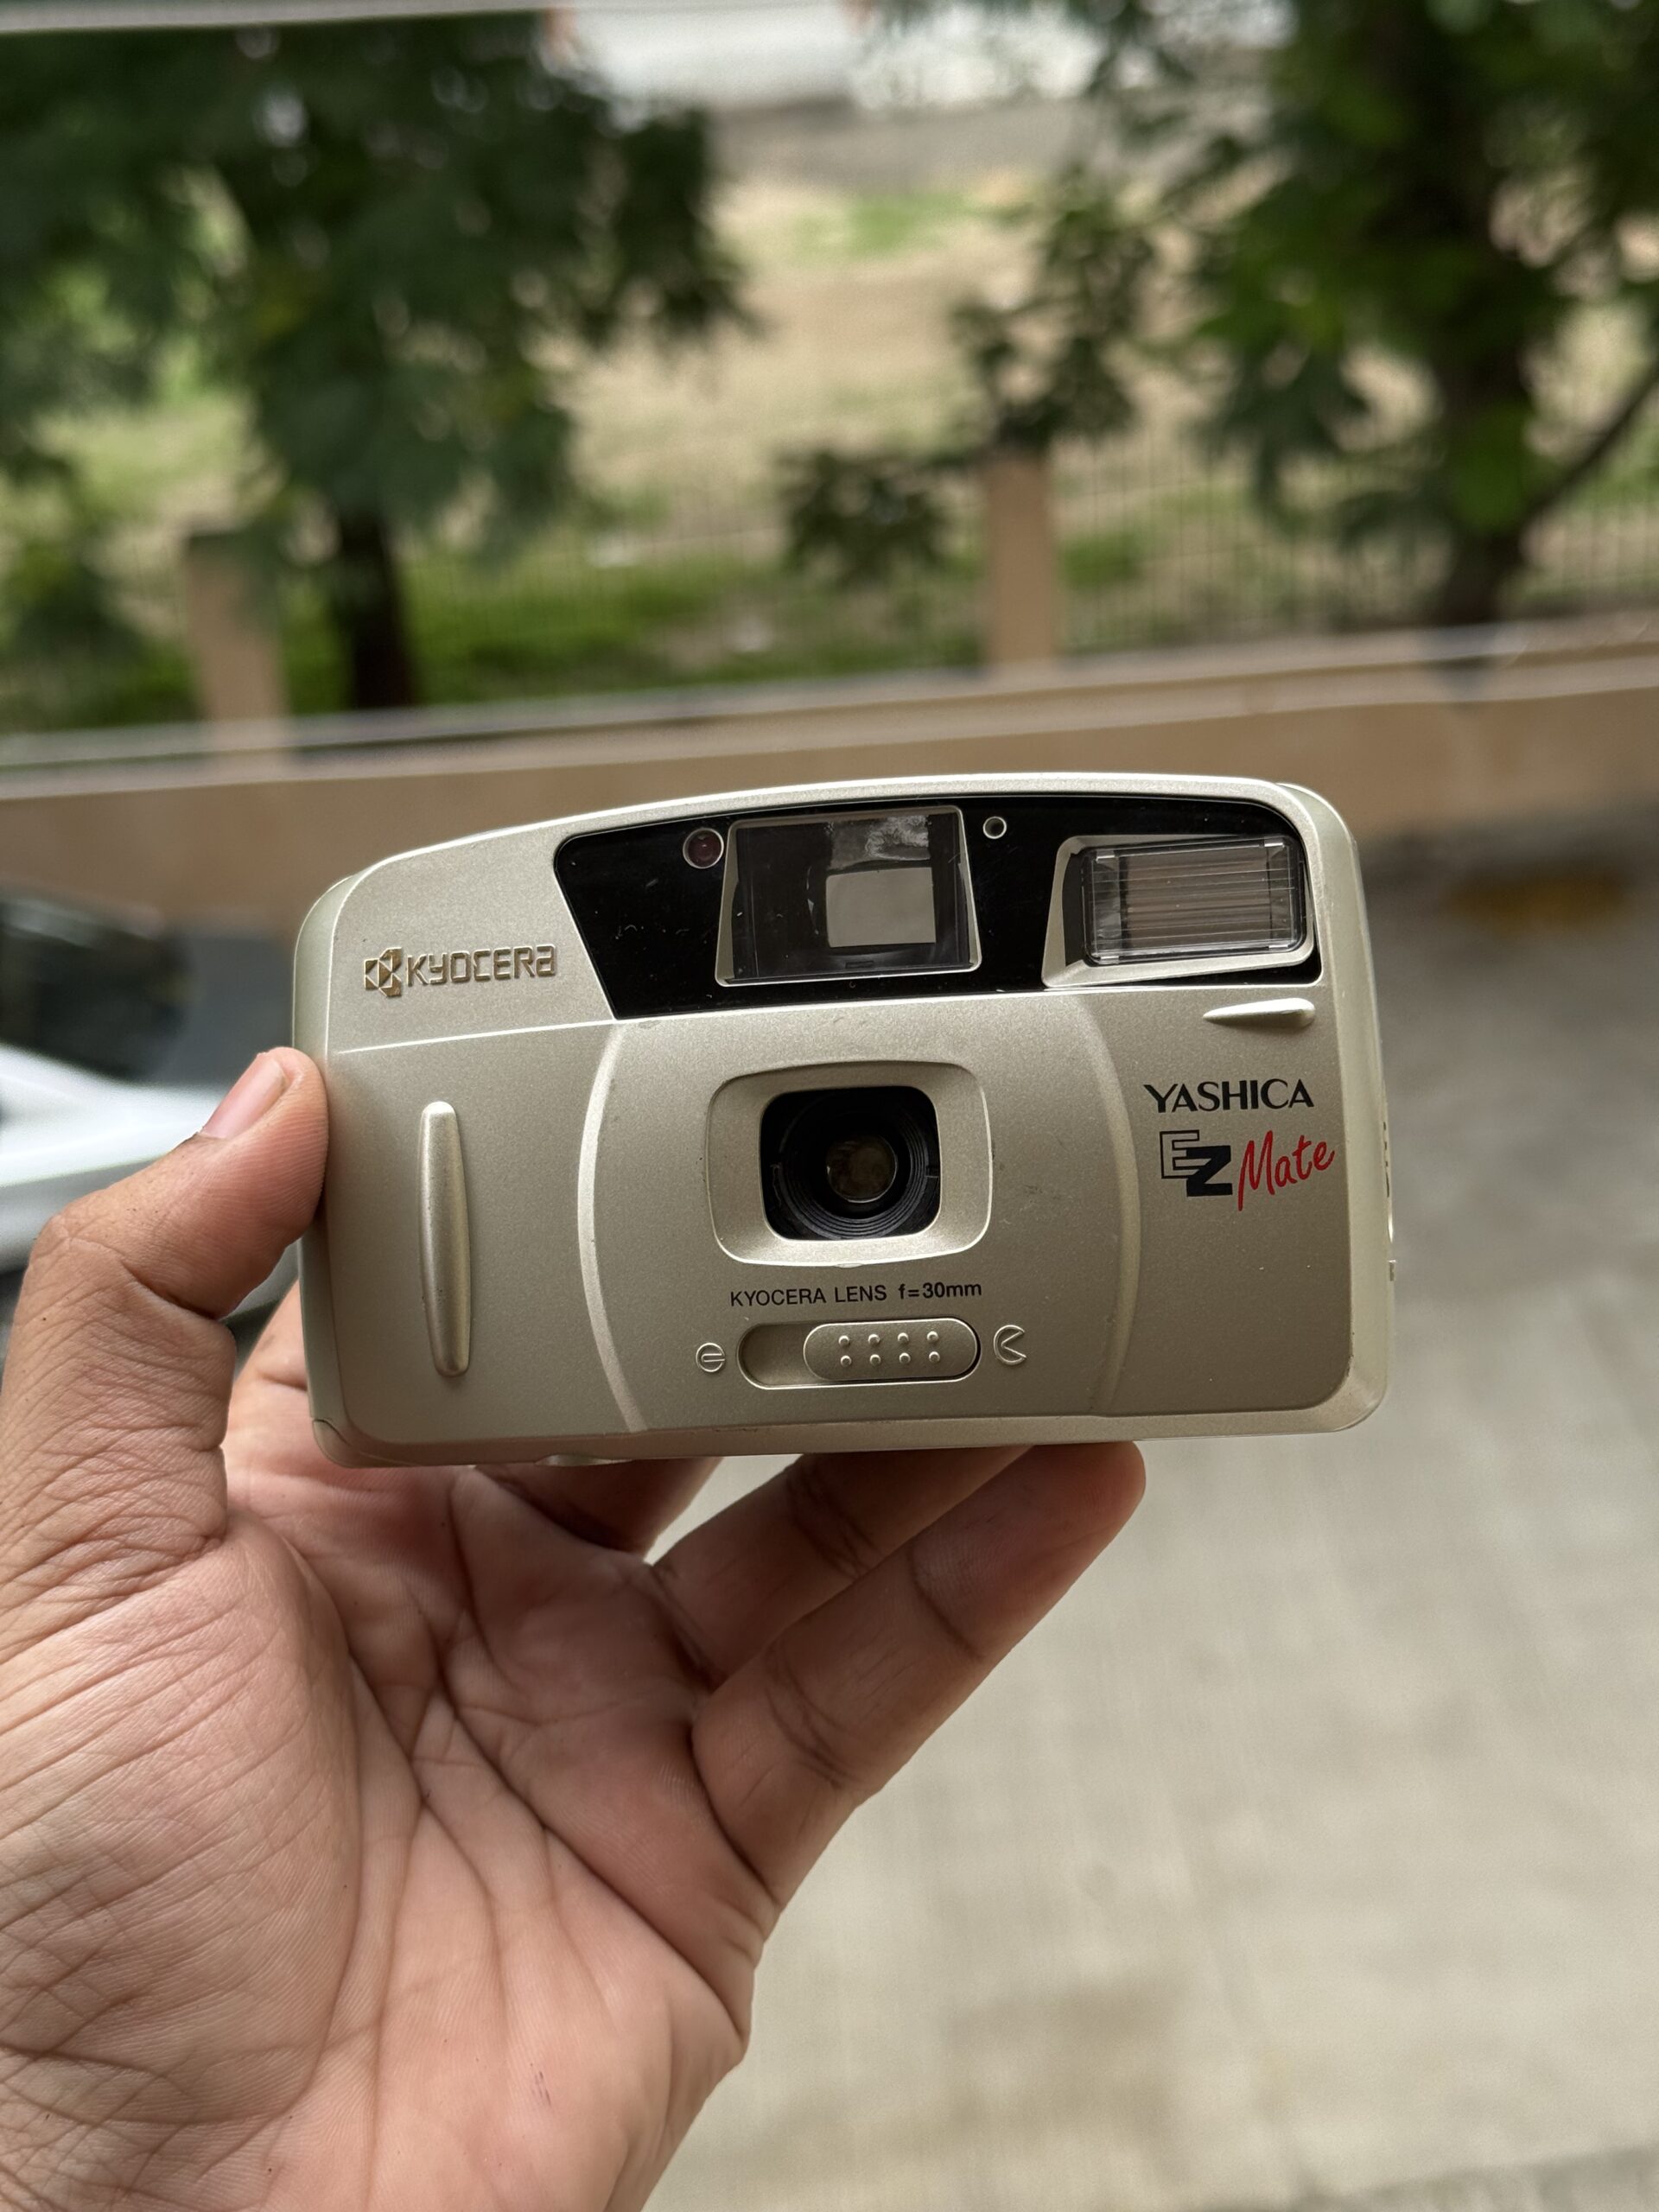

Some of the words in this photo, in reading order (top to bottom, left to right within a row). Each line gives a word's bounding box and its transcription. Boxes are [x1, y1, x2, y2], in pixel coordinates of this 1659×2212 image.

[406, 944, 556, 986] KYOCERA
[1143, 1078, 1314, 1113] YASHICA
[1159, 1129, 1233, 1197] EZ
[1238, 1129, 1335, 1211] Mate
[730, 1287, 827, 1306] KYOCERA
[835, 1284, 887, 1303] LENS
[898, 1281, 982, 1300] f=30mm
